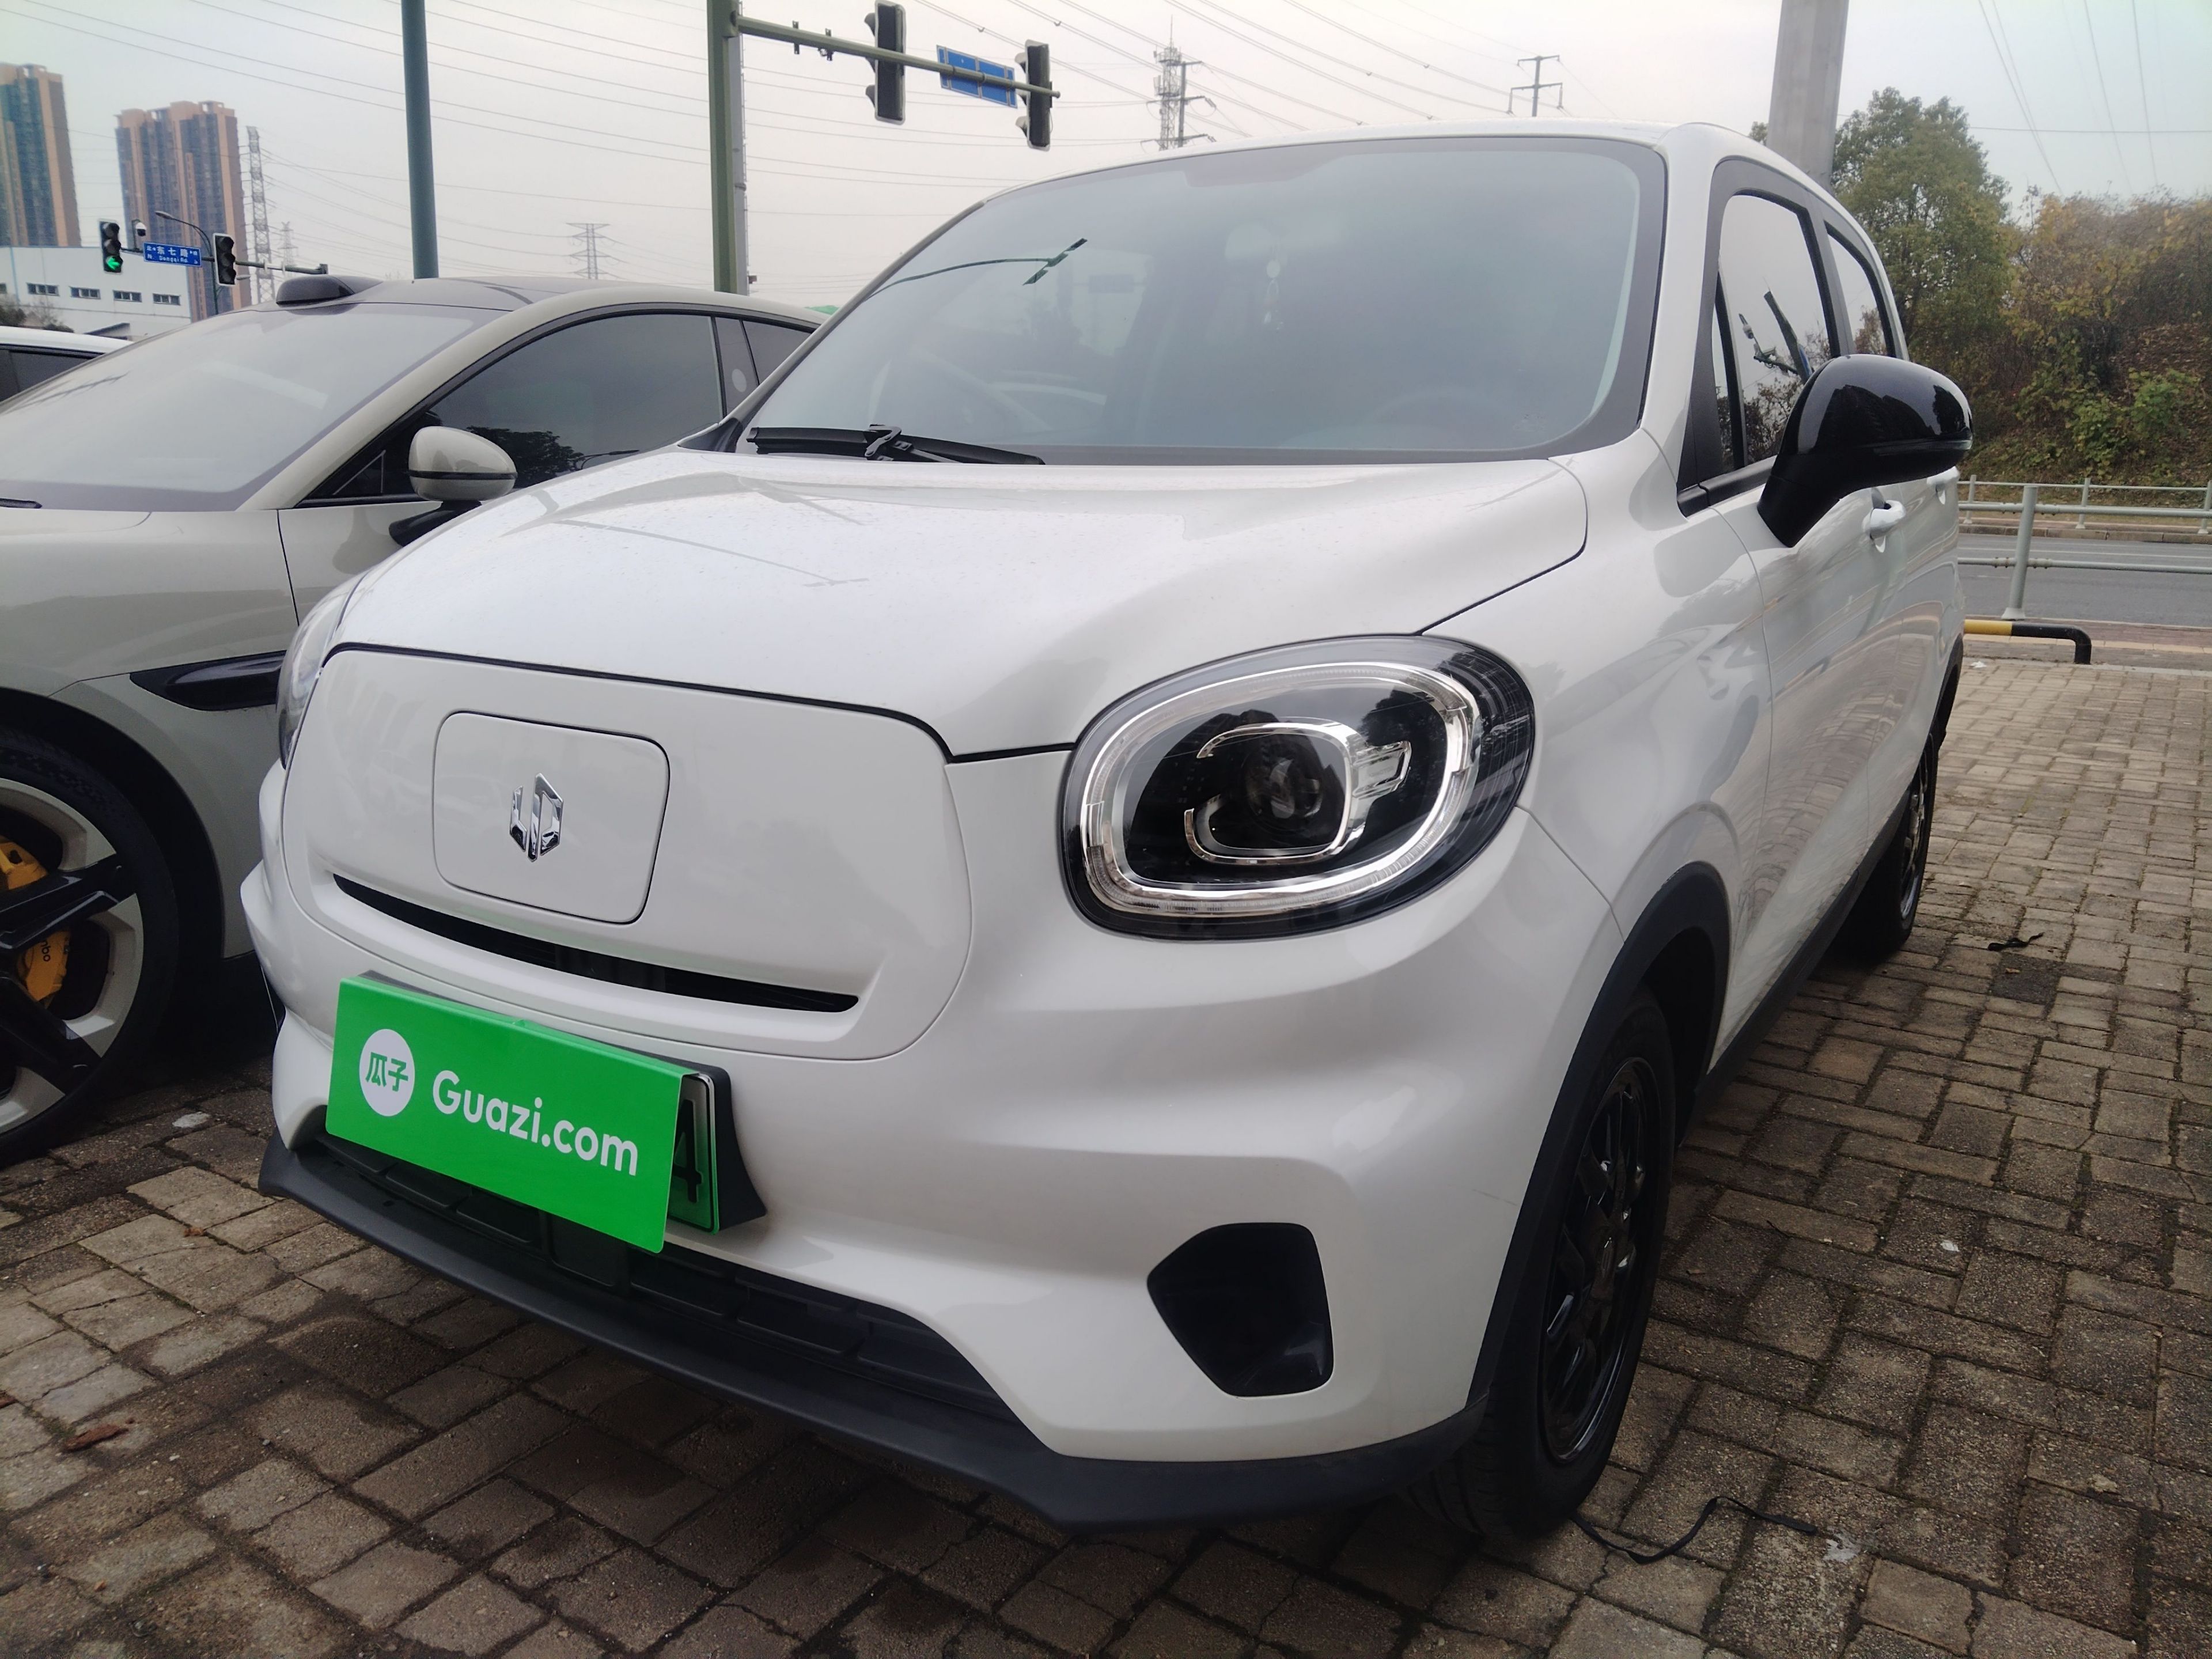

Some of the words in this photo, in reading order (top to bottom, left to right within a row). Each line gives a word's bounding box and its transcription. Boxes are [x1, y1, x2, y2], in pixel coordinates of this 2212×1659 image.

[40, 940, 51, 961] mbo
[365, 1052, 408, 1092] 瓜子
[433, 1070, 638, 1176] Guazi.com
